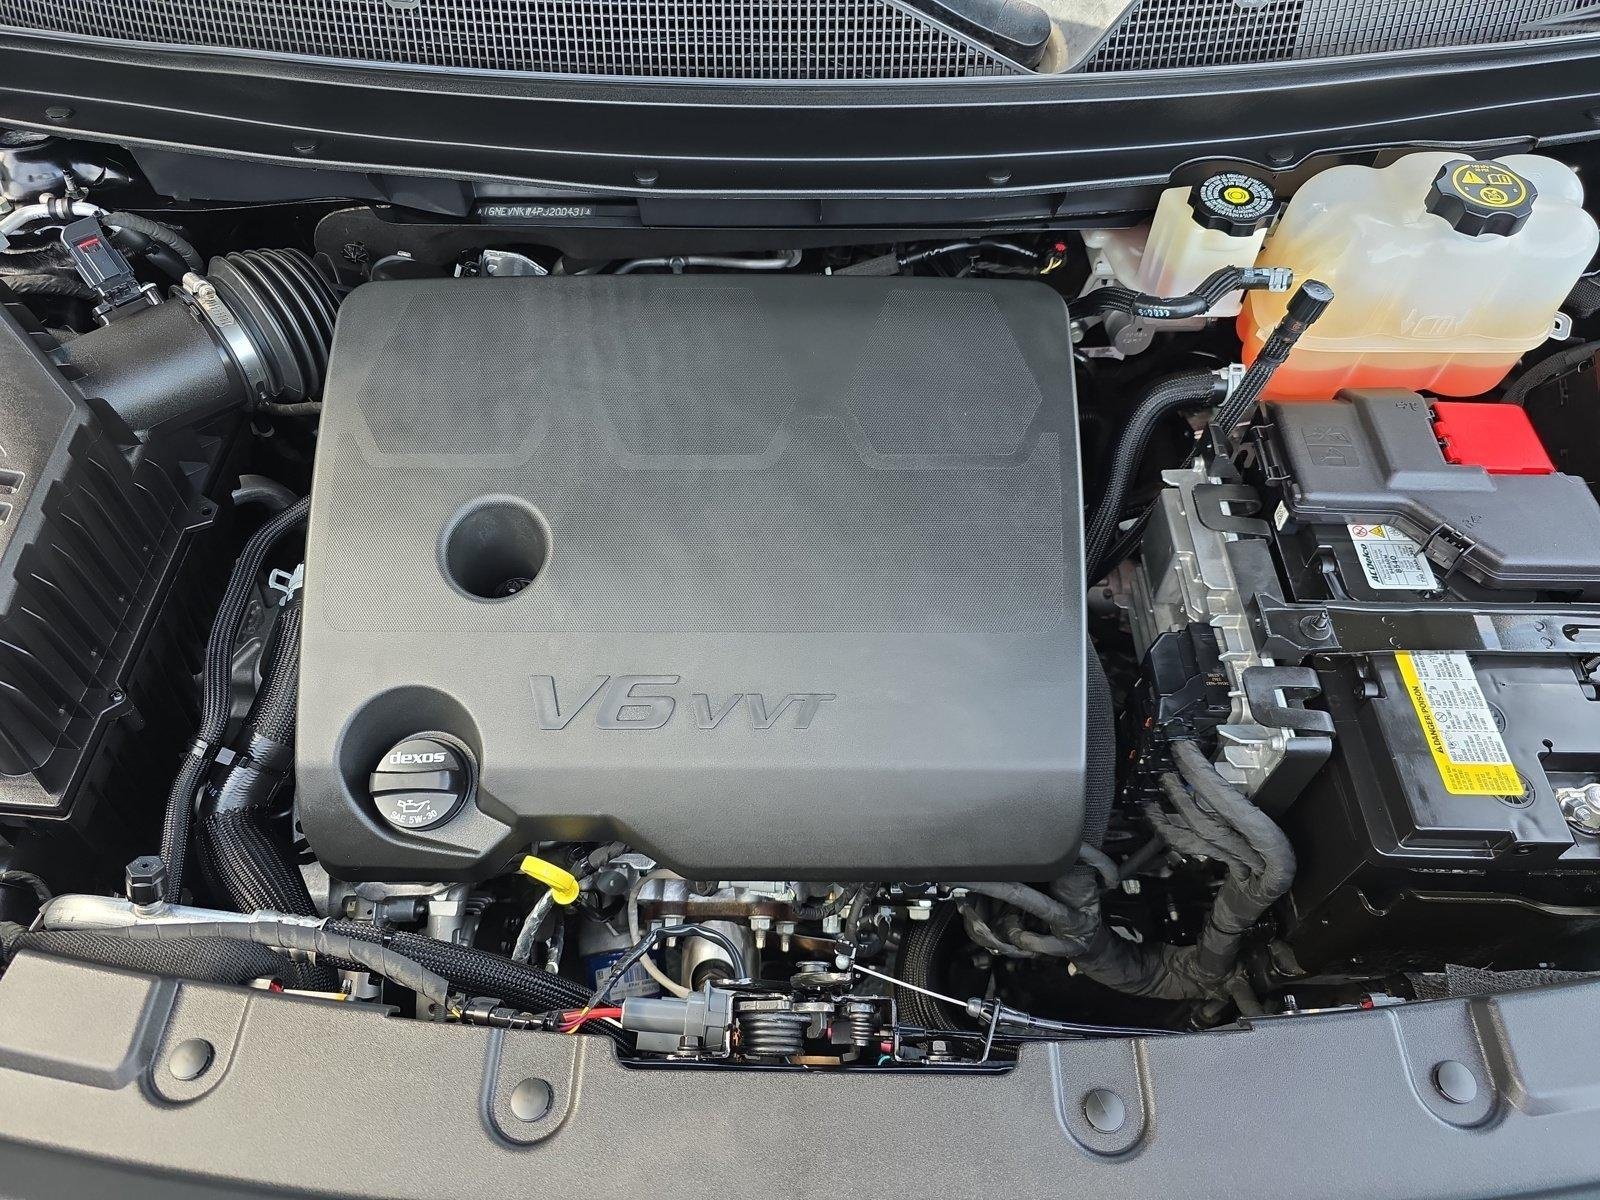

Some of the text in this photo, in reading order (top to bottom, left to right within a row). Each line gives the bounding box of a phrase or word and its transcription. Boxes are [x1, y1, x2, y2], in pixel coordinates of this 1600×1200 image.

[1360, 543, 1381, 584] ACDelco
[528, 674, 837, 731] V6 VVT
[389, 752, 448, 764] dexos
[390, 809, 438, 825] SAE 5W-30
